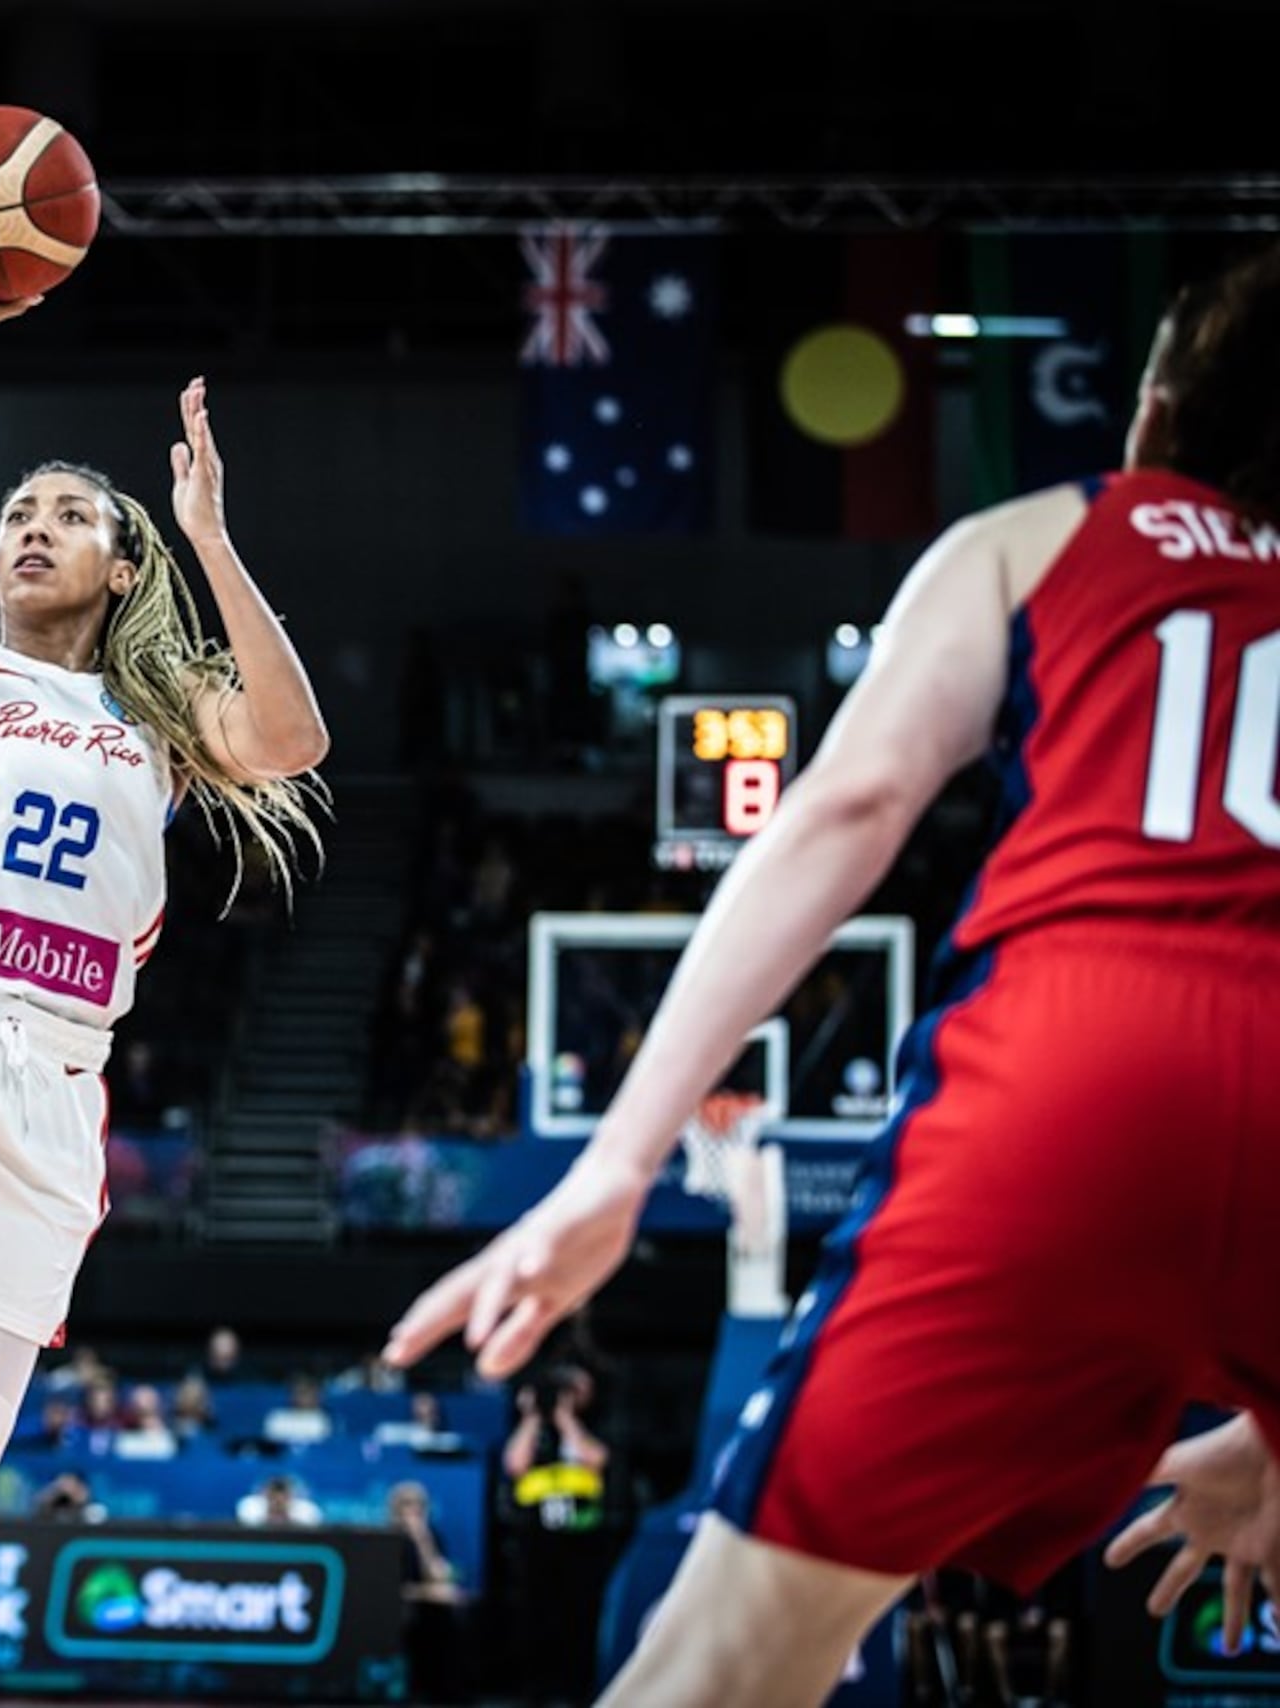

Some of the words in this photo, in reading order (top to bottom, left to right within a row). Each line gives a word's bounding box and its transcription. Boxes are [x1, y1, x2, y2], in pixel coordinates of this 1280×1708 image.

[85, 723, 146, 767] Rico
[724, 758, 780, 838] 8
[2, 789, 101, 892] 22
[140, 1567, 312, 1635] Smart
